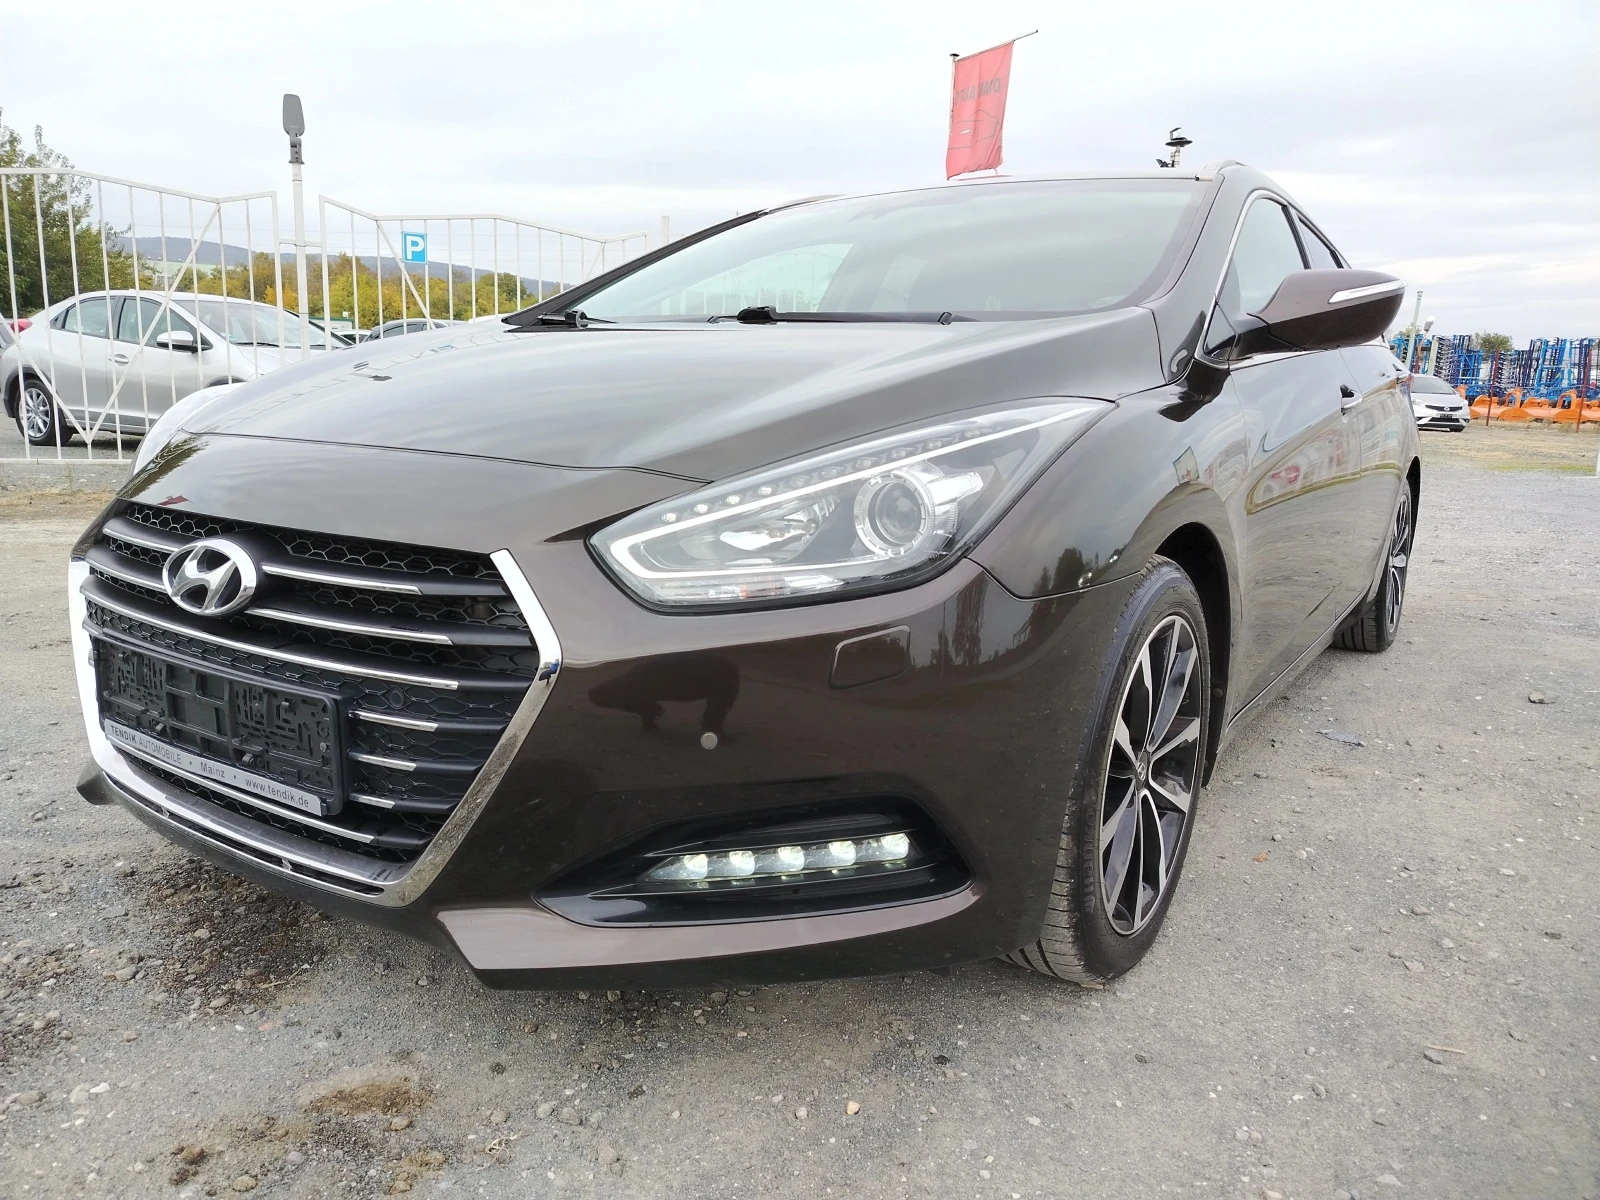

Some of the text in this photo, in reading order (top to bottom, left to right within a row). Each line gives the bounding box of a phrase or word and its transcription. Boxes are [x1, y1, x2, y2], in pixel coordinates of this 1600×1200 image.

[405, 235, 425, 260] P
[110, 724, 309, 808] TENDIK AUTOMOBILE Mainz www.tendik.de
